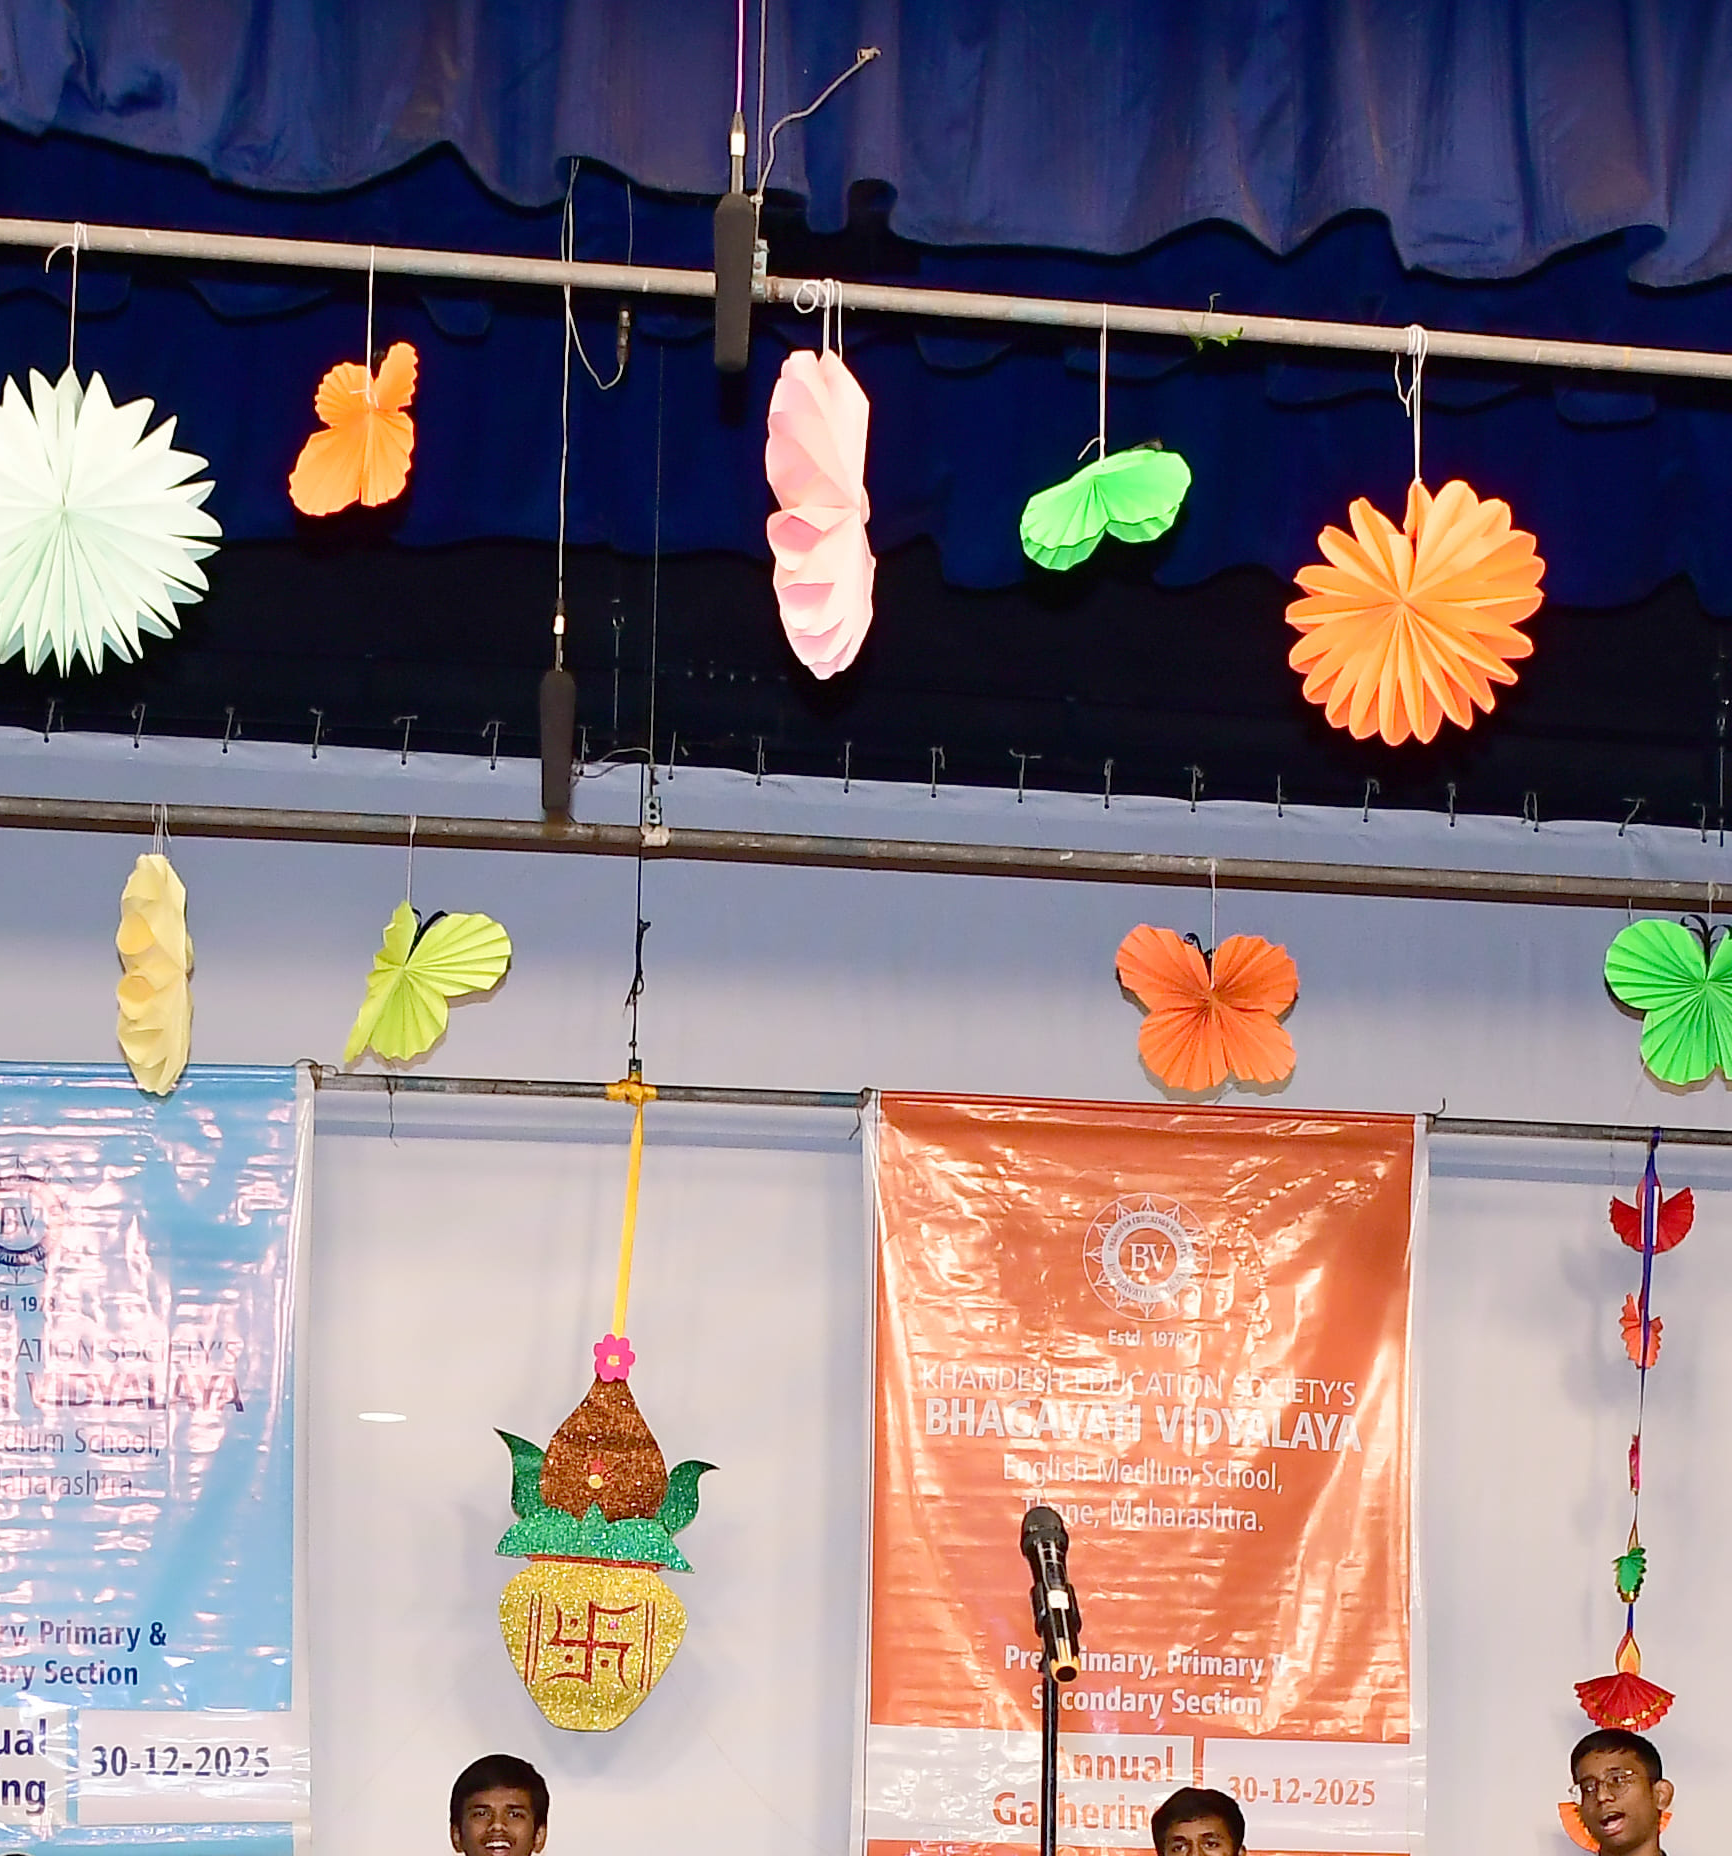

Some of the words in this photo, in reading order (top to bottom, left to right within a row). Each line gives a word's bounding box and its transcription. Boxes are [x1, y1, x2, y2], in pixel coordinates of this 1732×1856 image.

[0, 1206, 44, 1235] BV
[1129, 1242, 1170, 1272] BV
[1108, 1329, 1144, 1346] Estd.
[26, 1372, 245, 1413] VIDYALAYA
[922, 1365, 1064, 1393] KHANDESH
[1233, 1375, 1356, 1407] SOCIETY'S
[925, 1397, 1141, 1441] BHAGAVATI
[1155, 1405, 1362, 1452] VIDYALAYA
[74, 1426, 160, 1457] School,
[1003, 1454, 1088, 1487] English
[1097, 1456, 1193, 1486] Medium
[1201, 1460, 1283, 1495] School,
[1110, 1499, 1265, 1532] Maharashtra.
[39, 1620, 141, 1652] Primary
[148, 1621, 167, 1646] &
[44, 1660, 139, 1686] Section
[1004, 1644, 1157, 1680] Preimary,
[1167, 1648, 1265, 1682] Primary
[1031, 1684, 1164, 1719] Scondary
[1171, 1688, 1263, 1716] Section
[91, 1745, 270, 1777] 30-12-2025
[1228, 1775, 1376, 1807] 30-12-2025
[992, 1791, 1157, 1830] Gaherin
